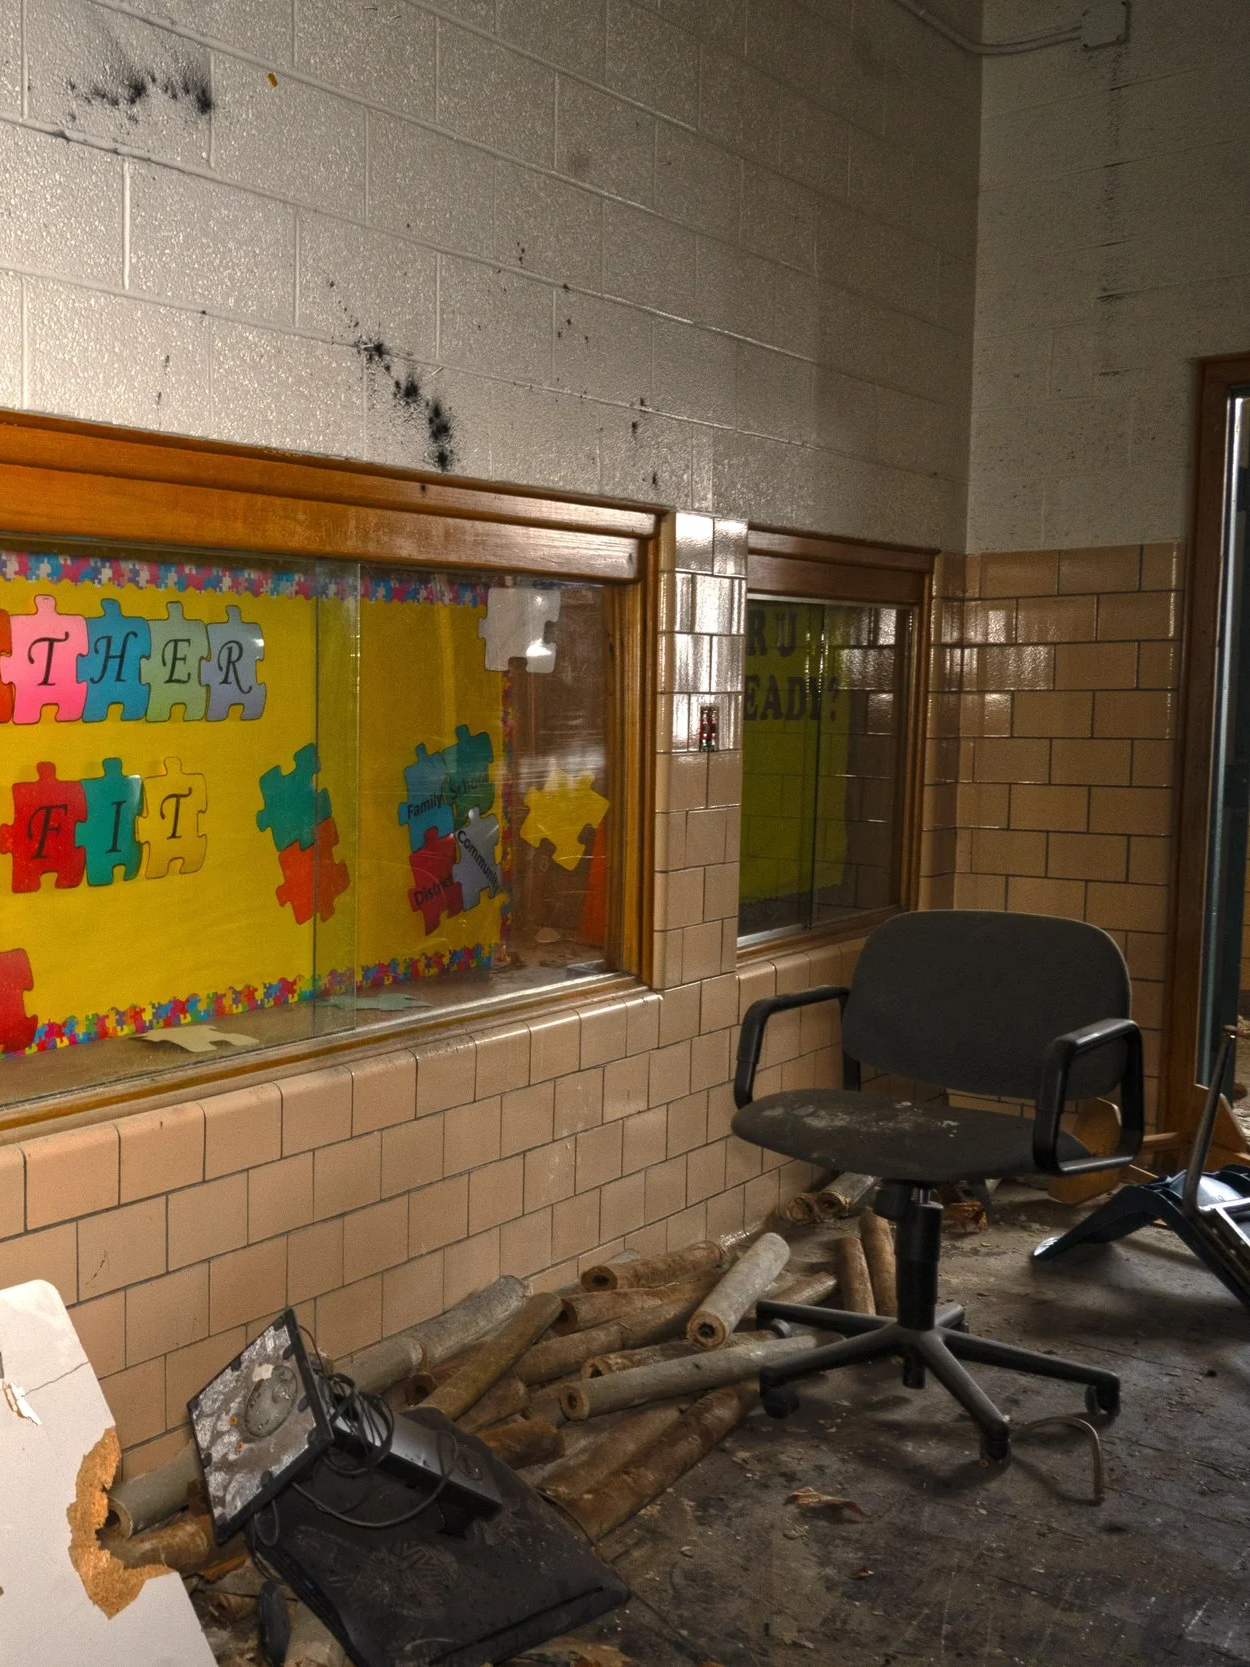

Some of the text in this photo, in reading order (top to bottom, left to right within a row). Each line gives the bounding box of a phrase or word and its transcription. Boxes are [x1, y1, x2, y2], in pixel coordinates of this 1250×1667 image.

[27, 787, 193, 860] FIT
[407, 789, 445, 818] Family
[457, 830, 501, 894] Community
